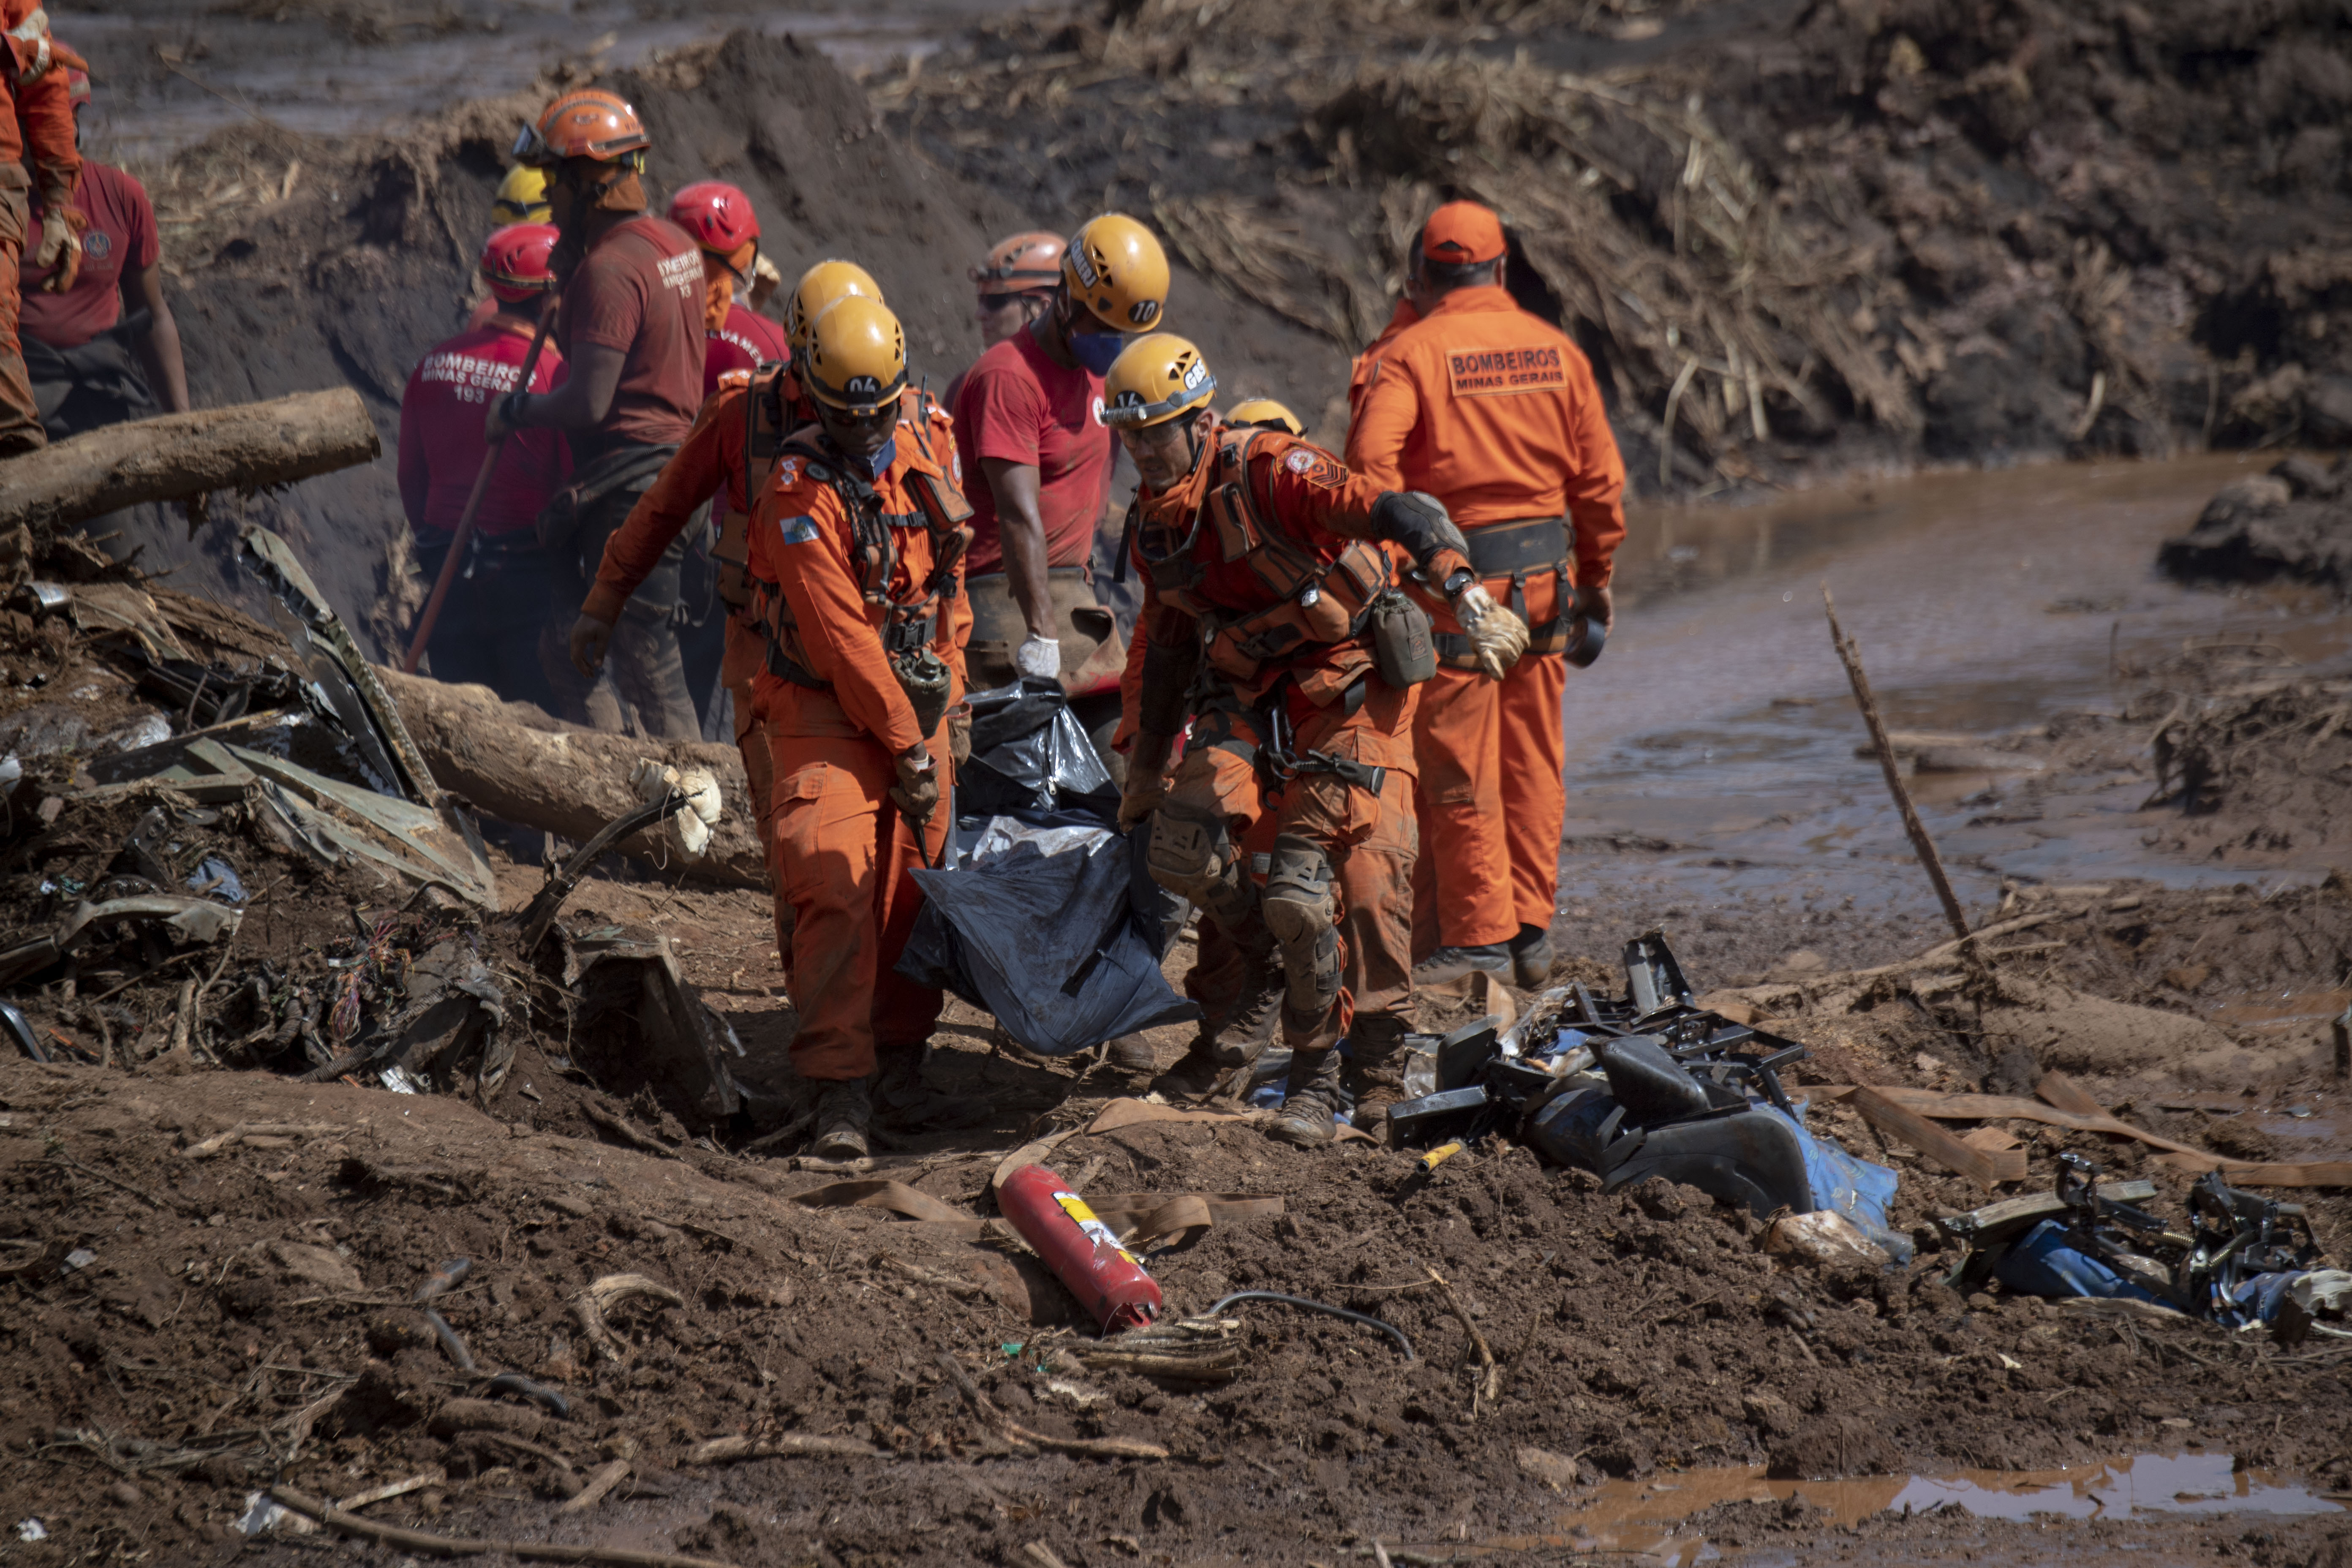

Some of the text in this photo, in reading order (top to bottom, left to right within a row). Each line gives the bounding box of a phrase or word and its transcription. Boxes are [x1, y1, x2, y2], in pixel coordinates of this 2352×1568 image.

[1133, 301, 1156, 322] 10
[1452, 349, 1559, 375] BOMBEIROS
[422, 367, 528, 393] MINAS GERA
[849, 376, 876, 393] 06
[1184, 358, 1206, 390] GBS
[1457, 372, 1563, 390] MINAS GERAIS
[454, 383, 485, 404] 193
